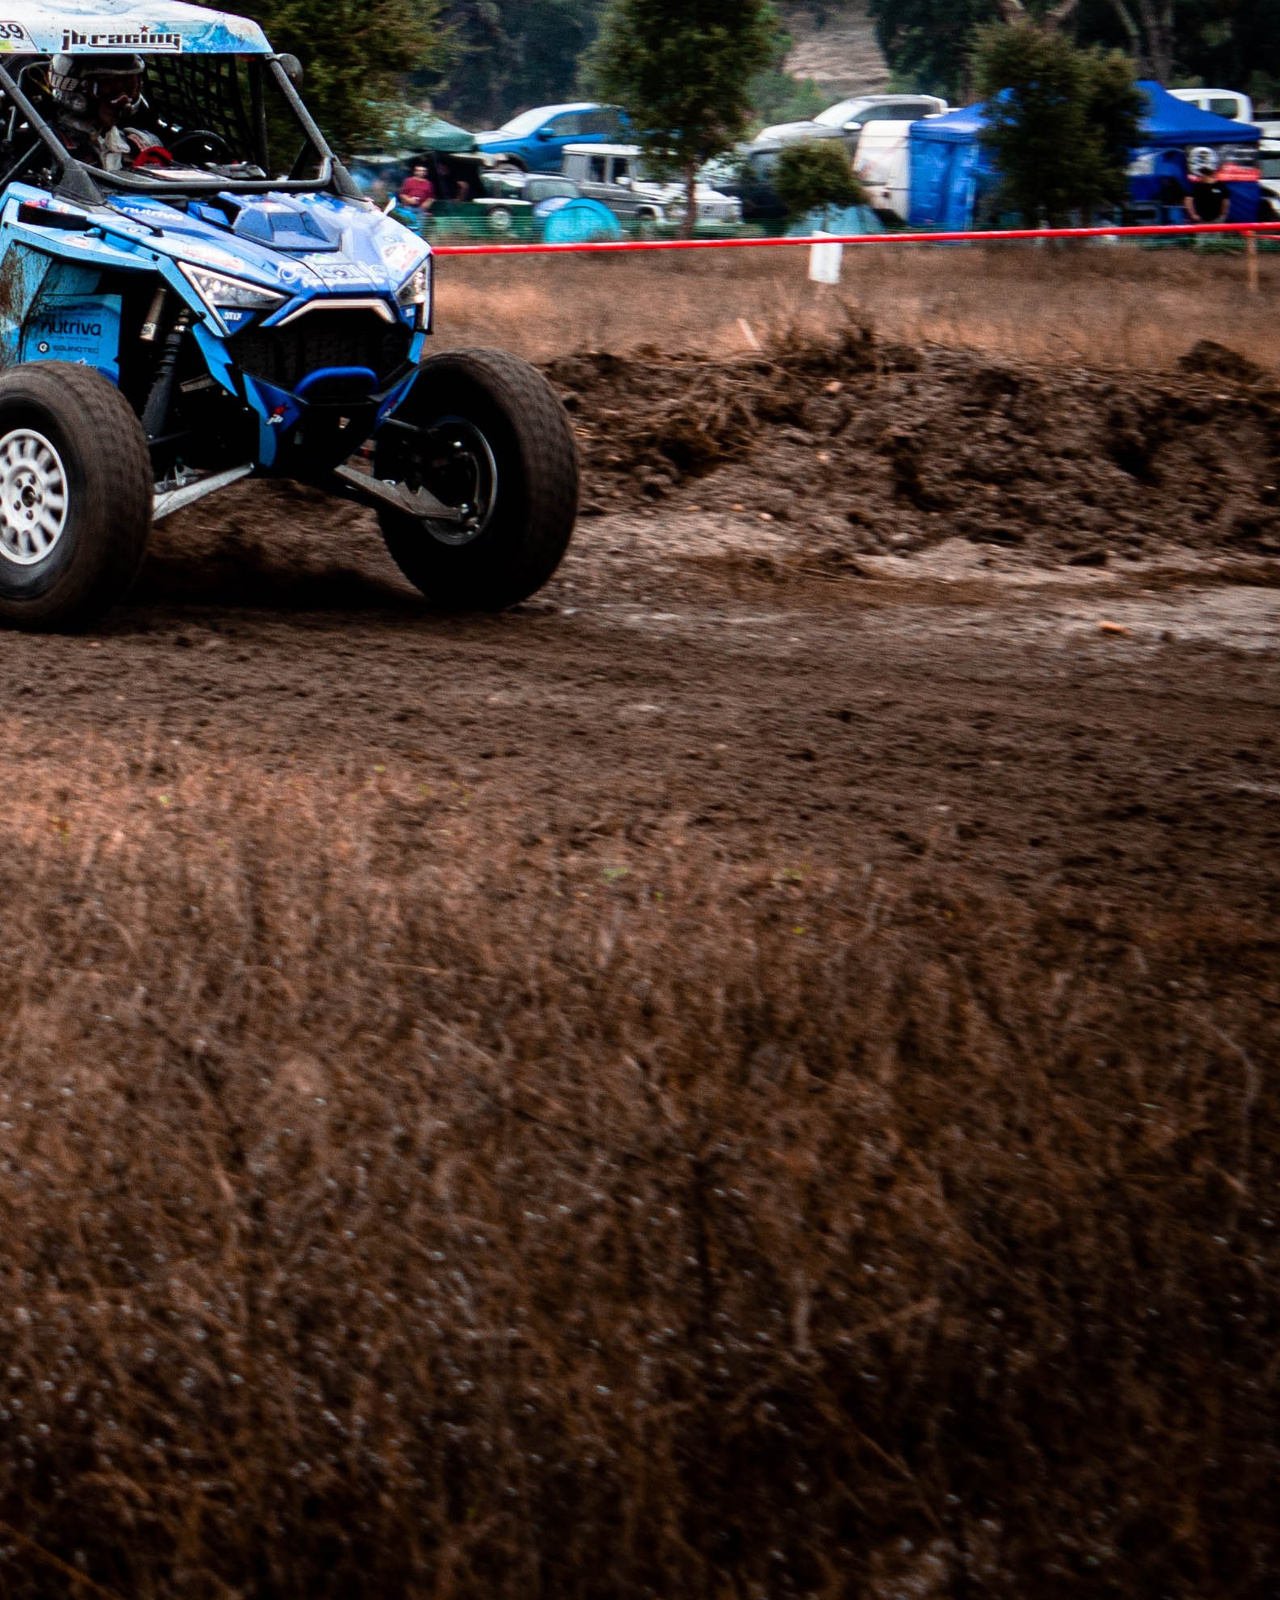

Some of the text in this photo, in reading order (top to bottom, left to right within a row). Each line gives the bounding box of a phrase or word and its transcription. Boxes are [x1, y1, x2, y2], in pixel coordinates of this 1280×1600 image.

[62, 26, 180, 50] jb racing
[40, 319, 102, 337] nutriva
